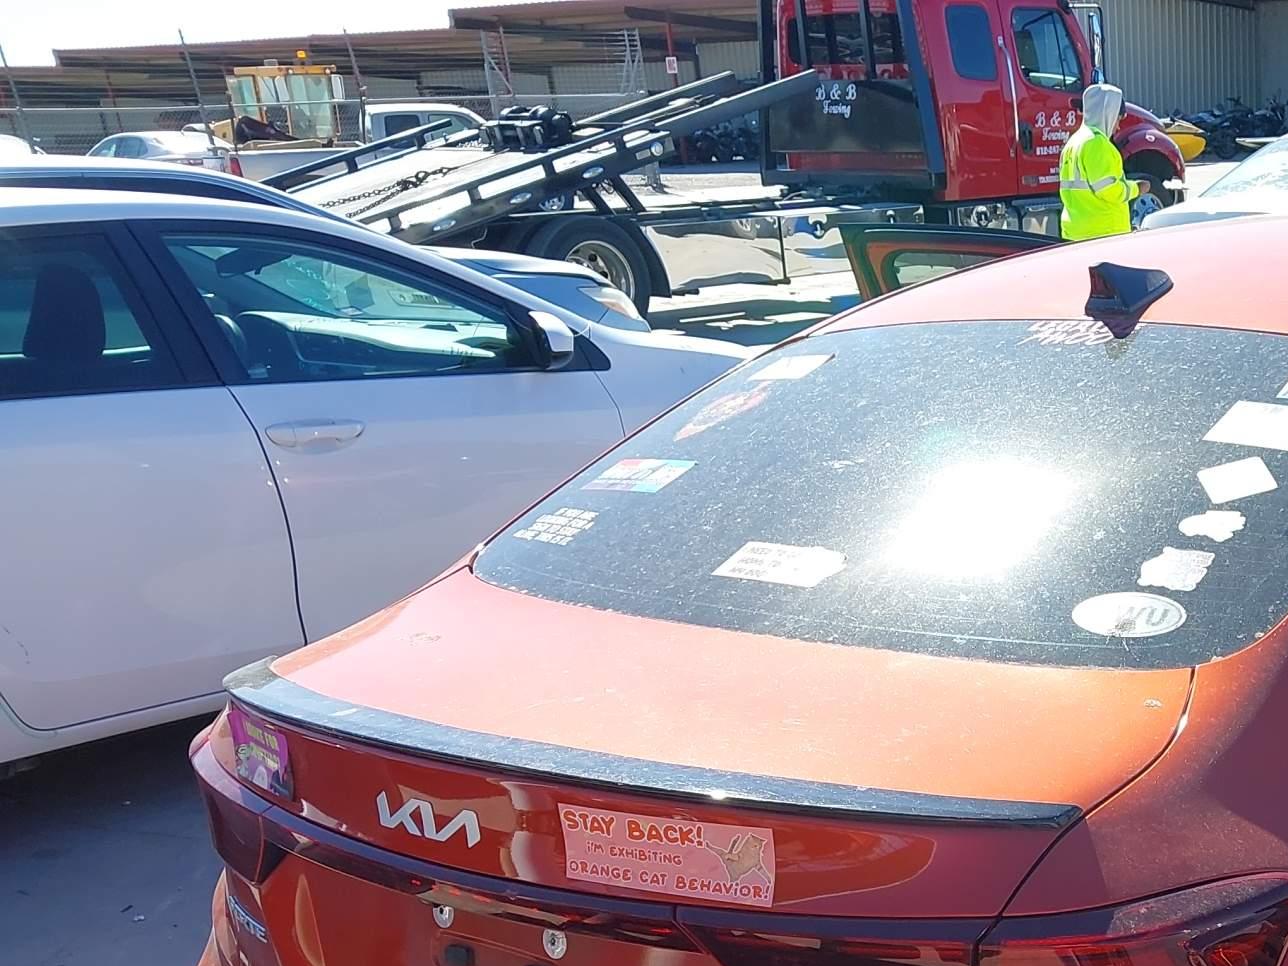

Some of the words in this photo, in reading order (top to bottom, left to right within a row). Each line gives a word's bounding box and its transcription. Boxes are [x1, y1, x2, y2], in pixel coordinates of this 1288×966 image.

[830, 83, 842, 100] &
[845, 83, 857, 100] B
[823, 99, 851, 118] Towing
[1034, 111, 1046, 128] B
[1050, 110, 1062, 127] &
[1065, 110, 1076, 126] B
[1042, 127, 1070, 143] Towing
[376, 790, 481, 849] KIA
[562, 810, 616, 837] STAY
[626, 819, 704, 848] BACK!
[569, 860, 632, 882] ORANGE
[639, 870, 668, 887] CAT
